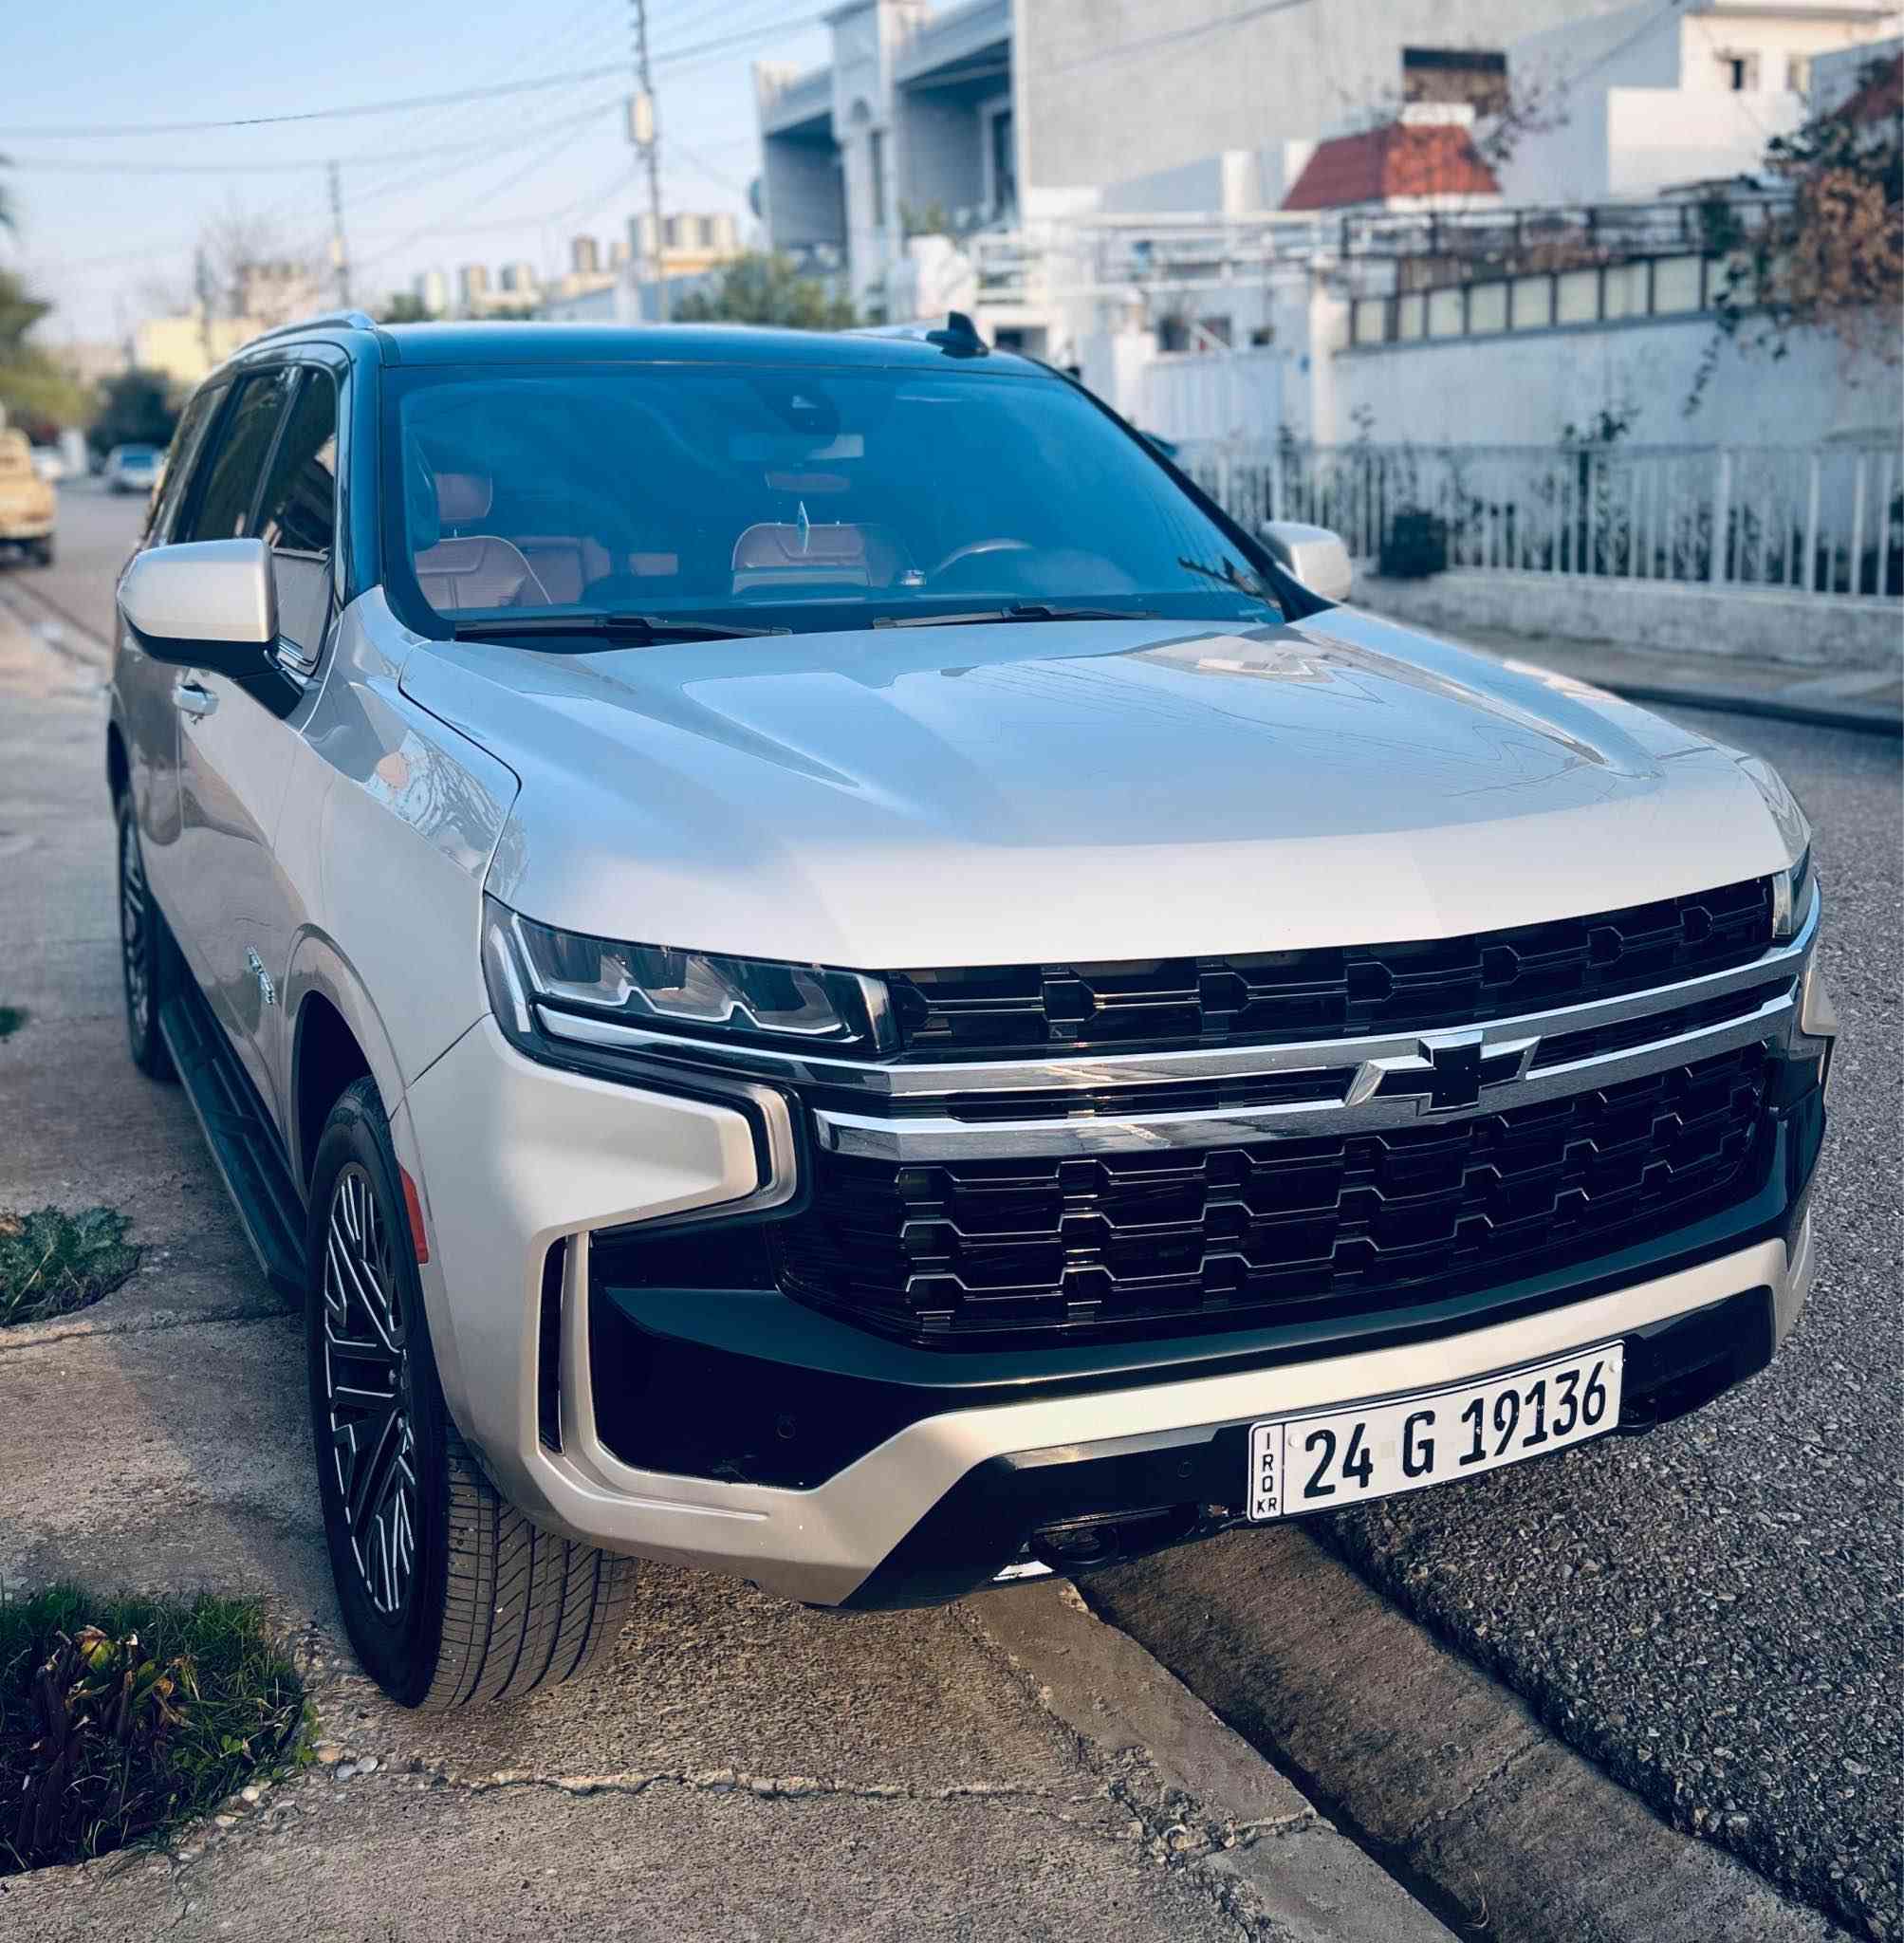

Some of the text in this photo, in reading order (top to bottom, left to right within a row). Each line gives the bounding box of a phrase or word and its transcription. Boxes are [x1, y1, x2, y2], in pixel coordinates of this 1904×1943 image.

[1304, 1360, 1606, 1498] 24 G 19136
[1256, 1497, 1277, 1514] KR
